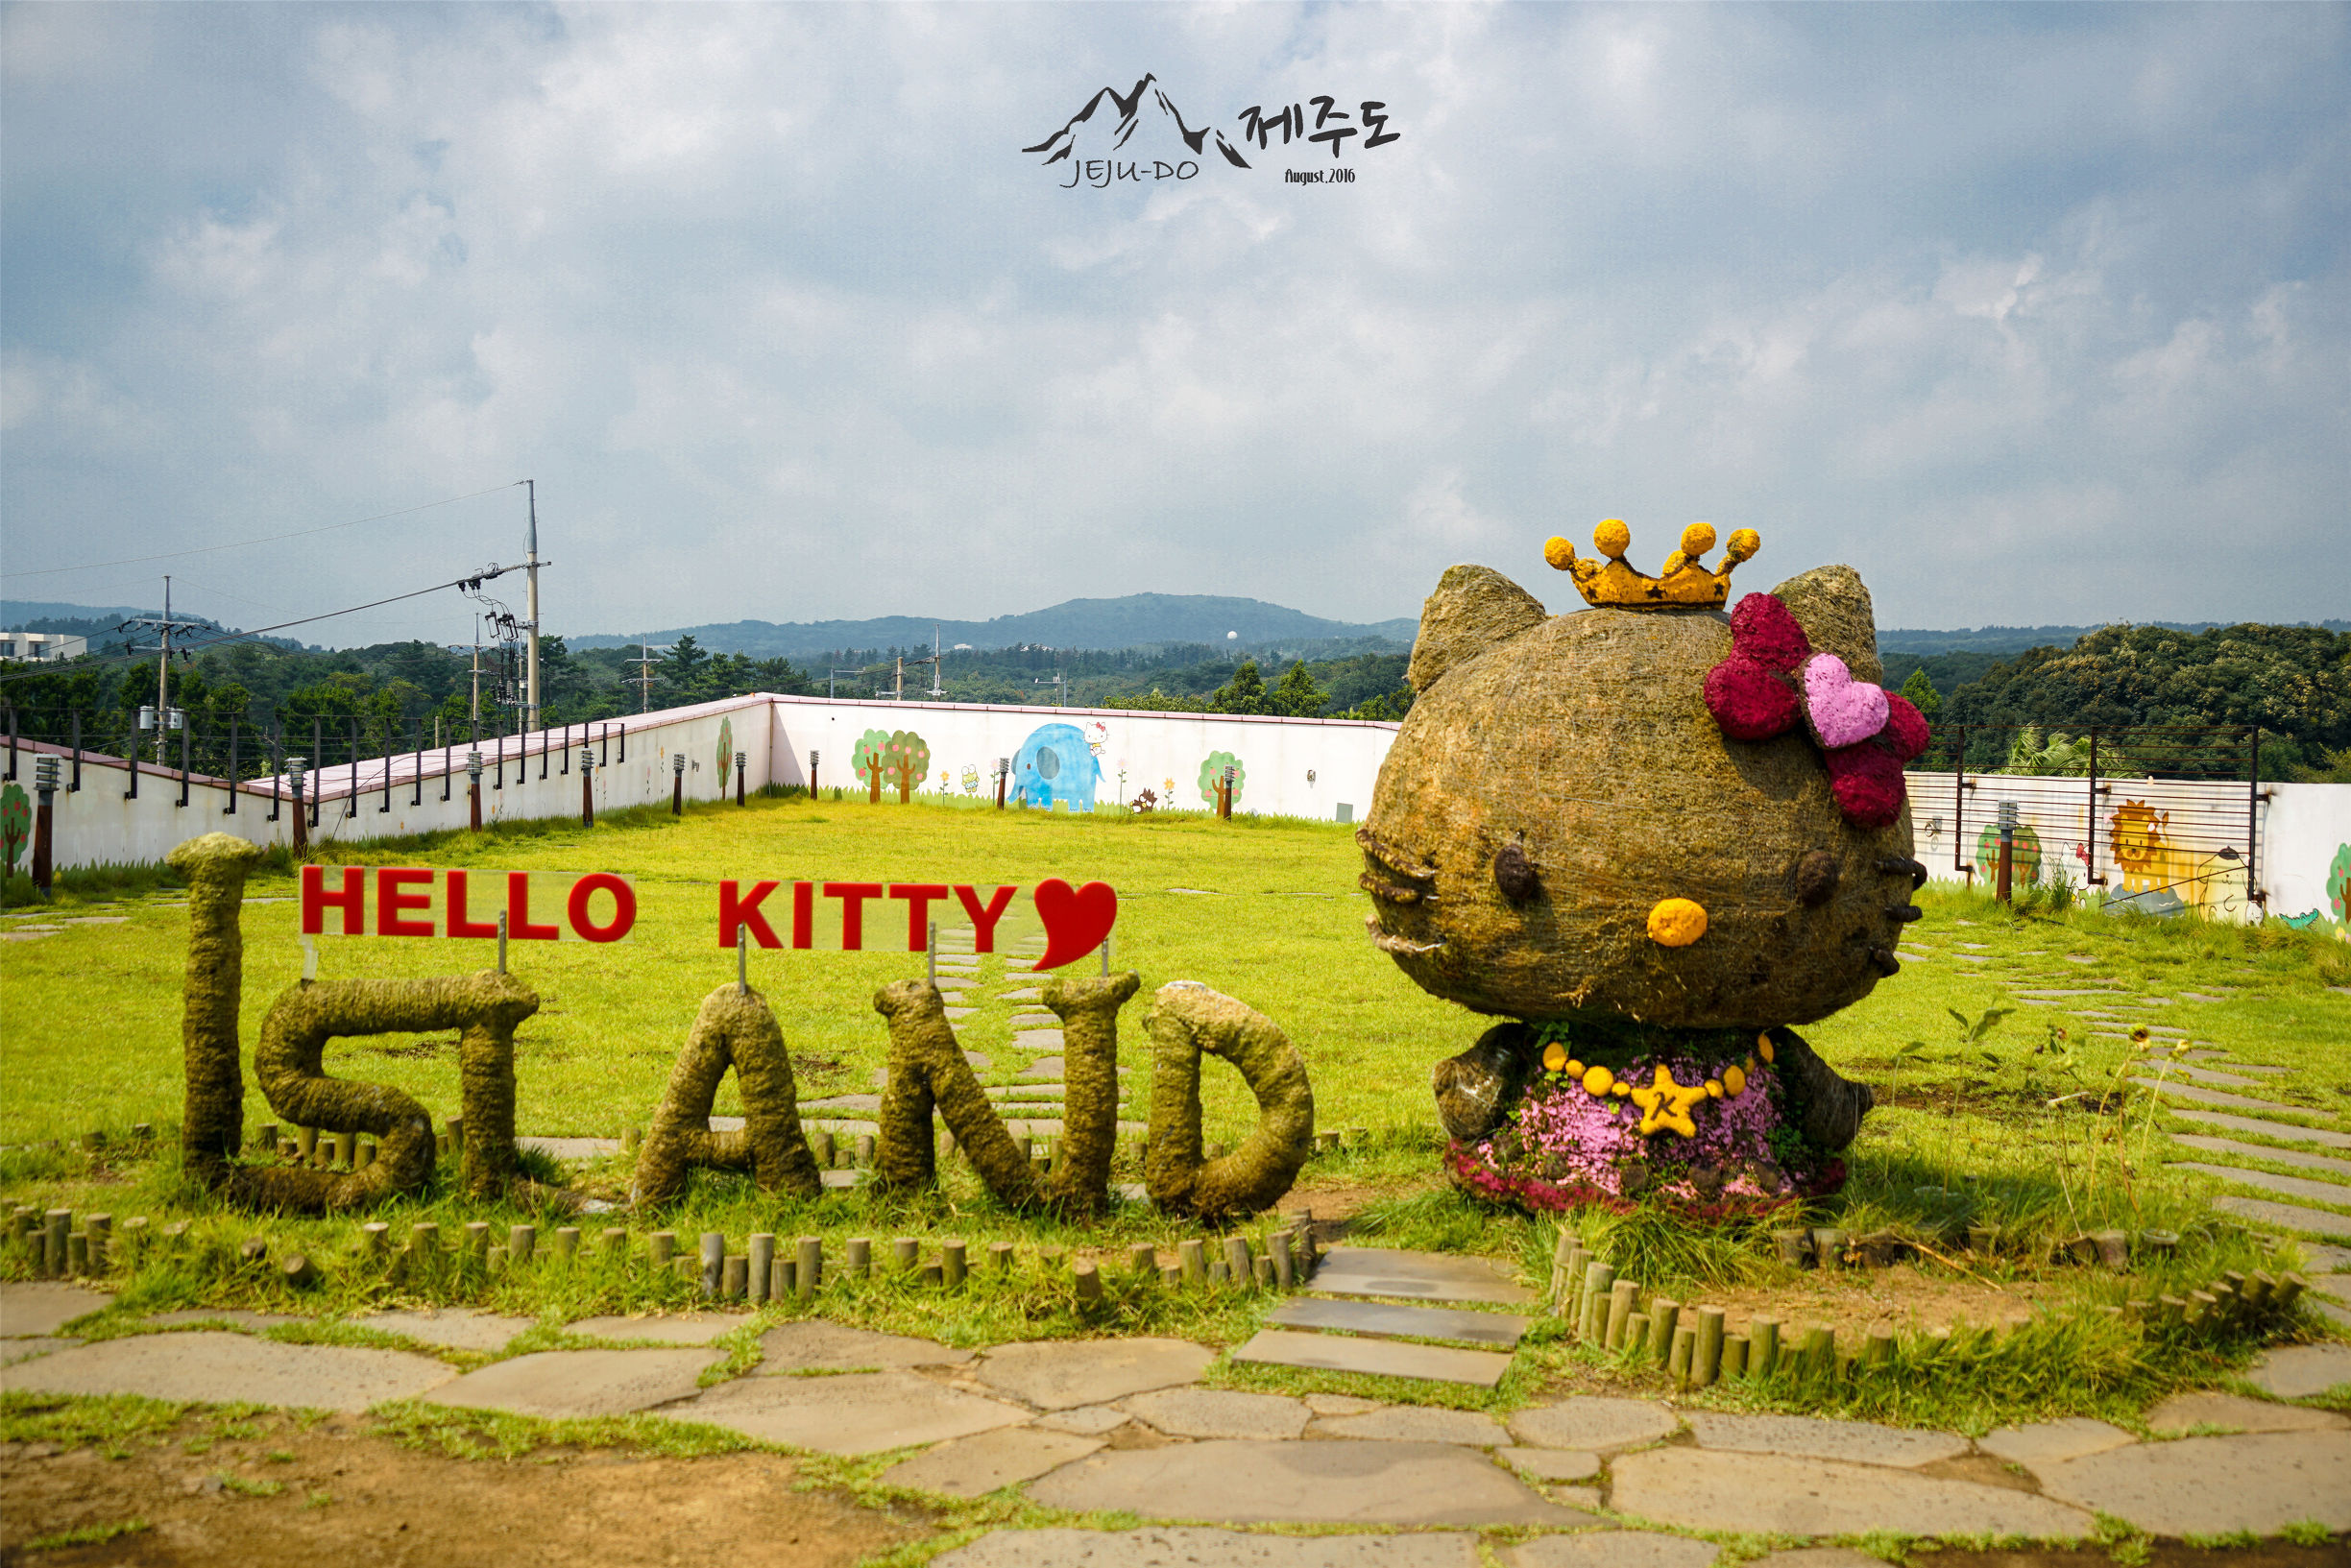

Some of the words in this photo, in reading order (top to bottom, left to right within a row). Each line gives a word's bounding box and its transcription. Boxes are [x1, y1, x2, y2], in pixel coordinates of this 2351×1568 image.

[303, 866, 636, 943] HELLO
[719, 880, 1017, 953] KITTY
[1650, 1092, 1678, 1122] K
